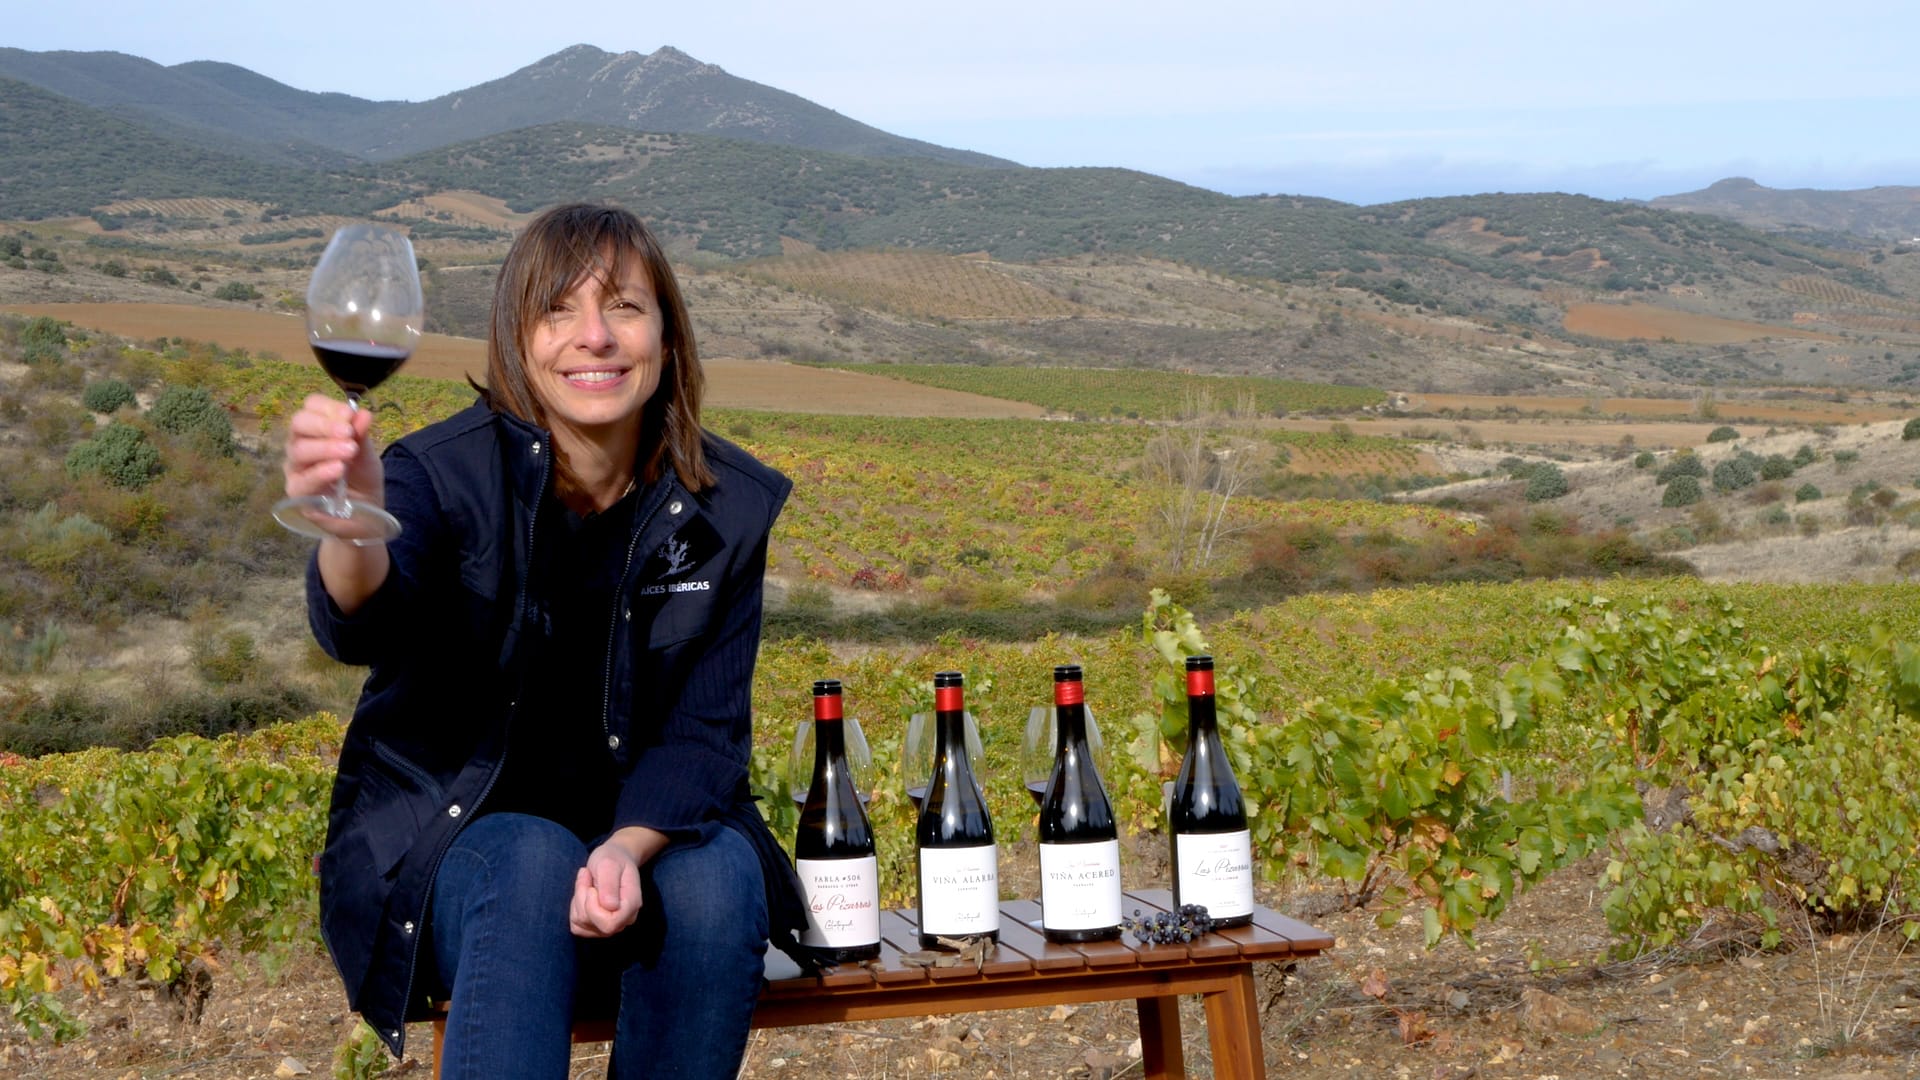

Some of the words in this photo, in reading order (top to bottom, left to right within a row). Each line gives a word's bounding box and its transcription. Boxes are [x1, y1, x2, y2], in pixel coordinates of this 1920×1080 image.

[640, 583, 665, 595] AÍCES
[668, 581, 710, 593] IBÉRICAS
[1050, 871, 1073, 880] VIÑA
[1078, 869, 1115, 880] ACERED
[808, 894, 823, 914] Las
